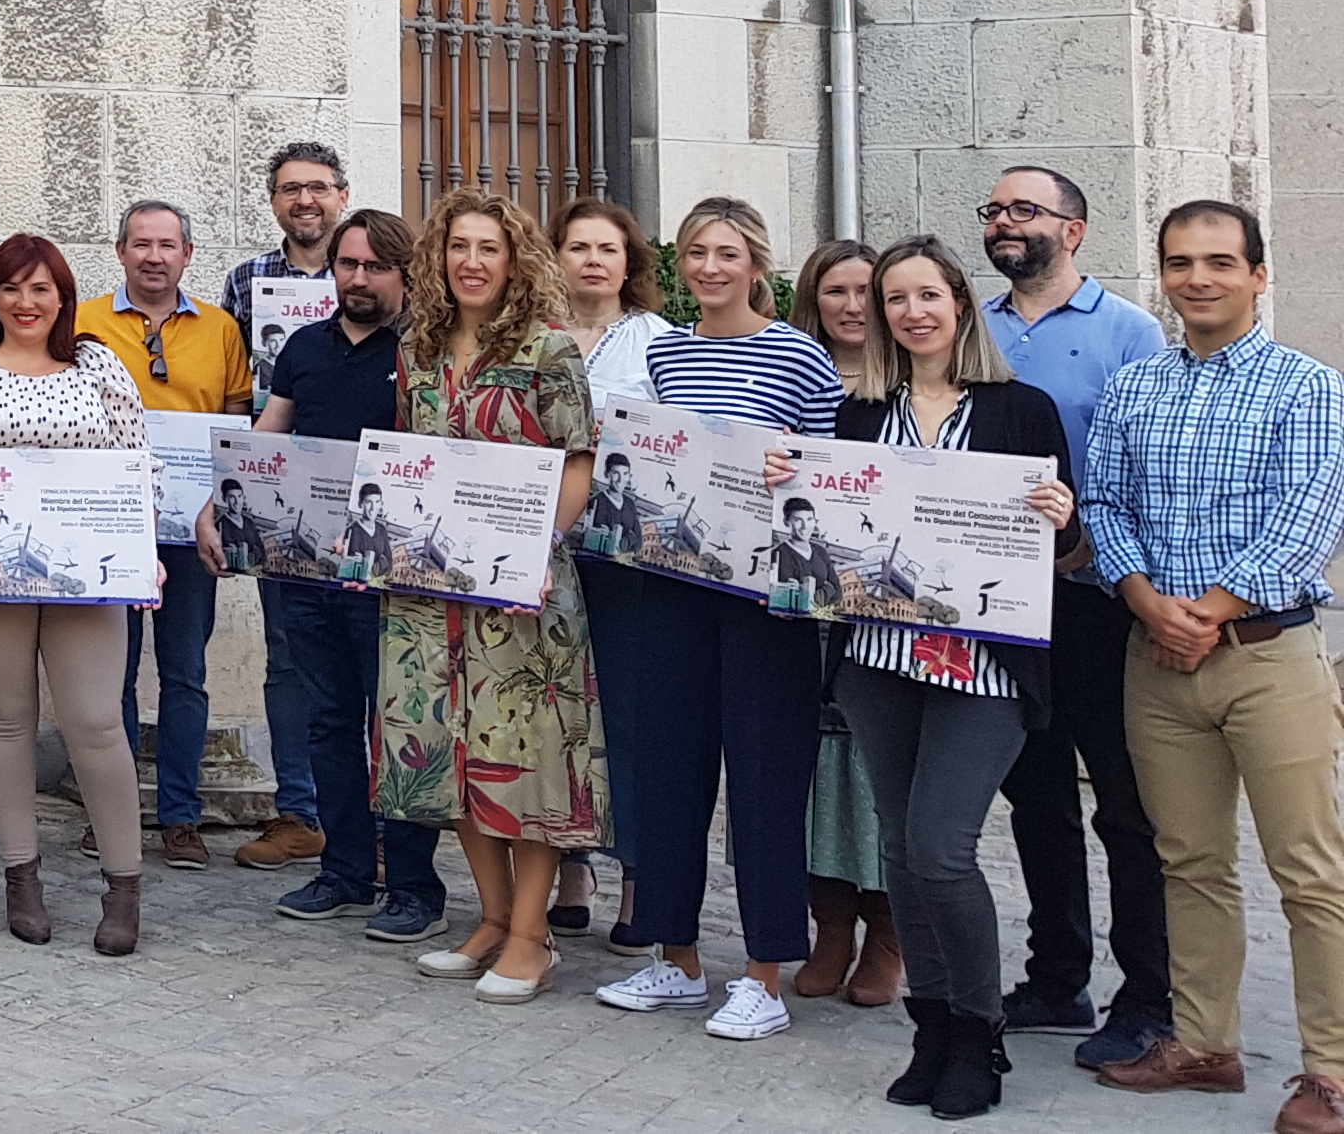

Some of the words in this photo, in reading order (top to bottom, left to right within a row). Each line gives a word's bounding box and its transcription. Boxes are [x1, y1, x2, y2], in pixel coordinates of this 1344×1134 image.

[914, 504, 950, 516] Miembro
[952, 508, 966, 518] del
[967, 510, 1010, 522] Consorcio
[933, 516, 971, 528] Diputación
[973, 521, 1009, 531] Provincial
[1023, 526, 1040, 534] Jaén
